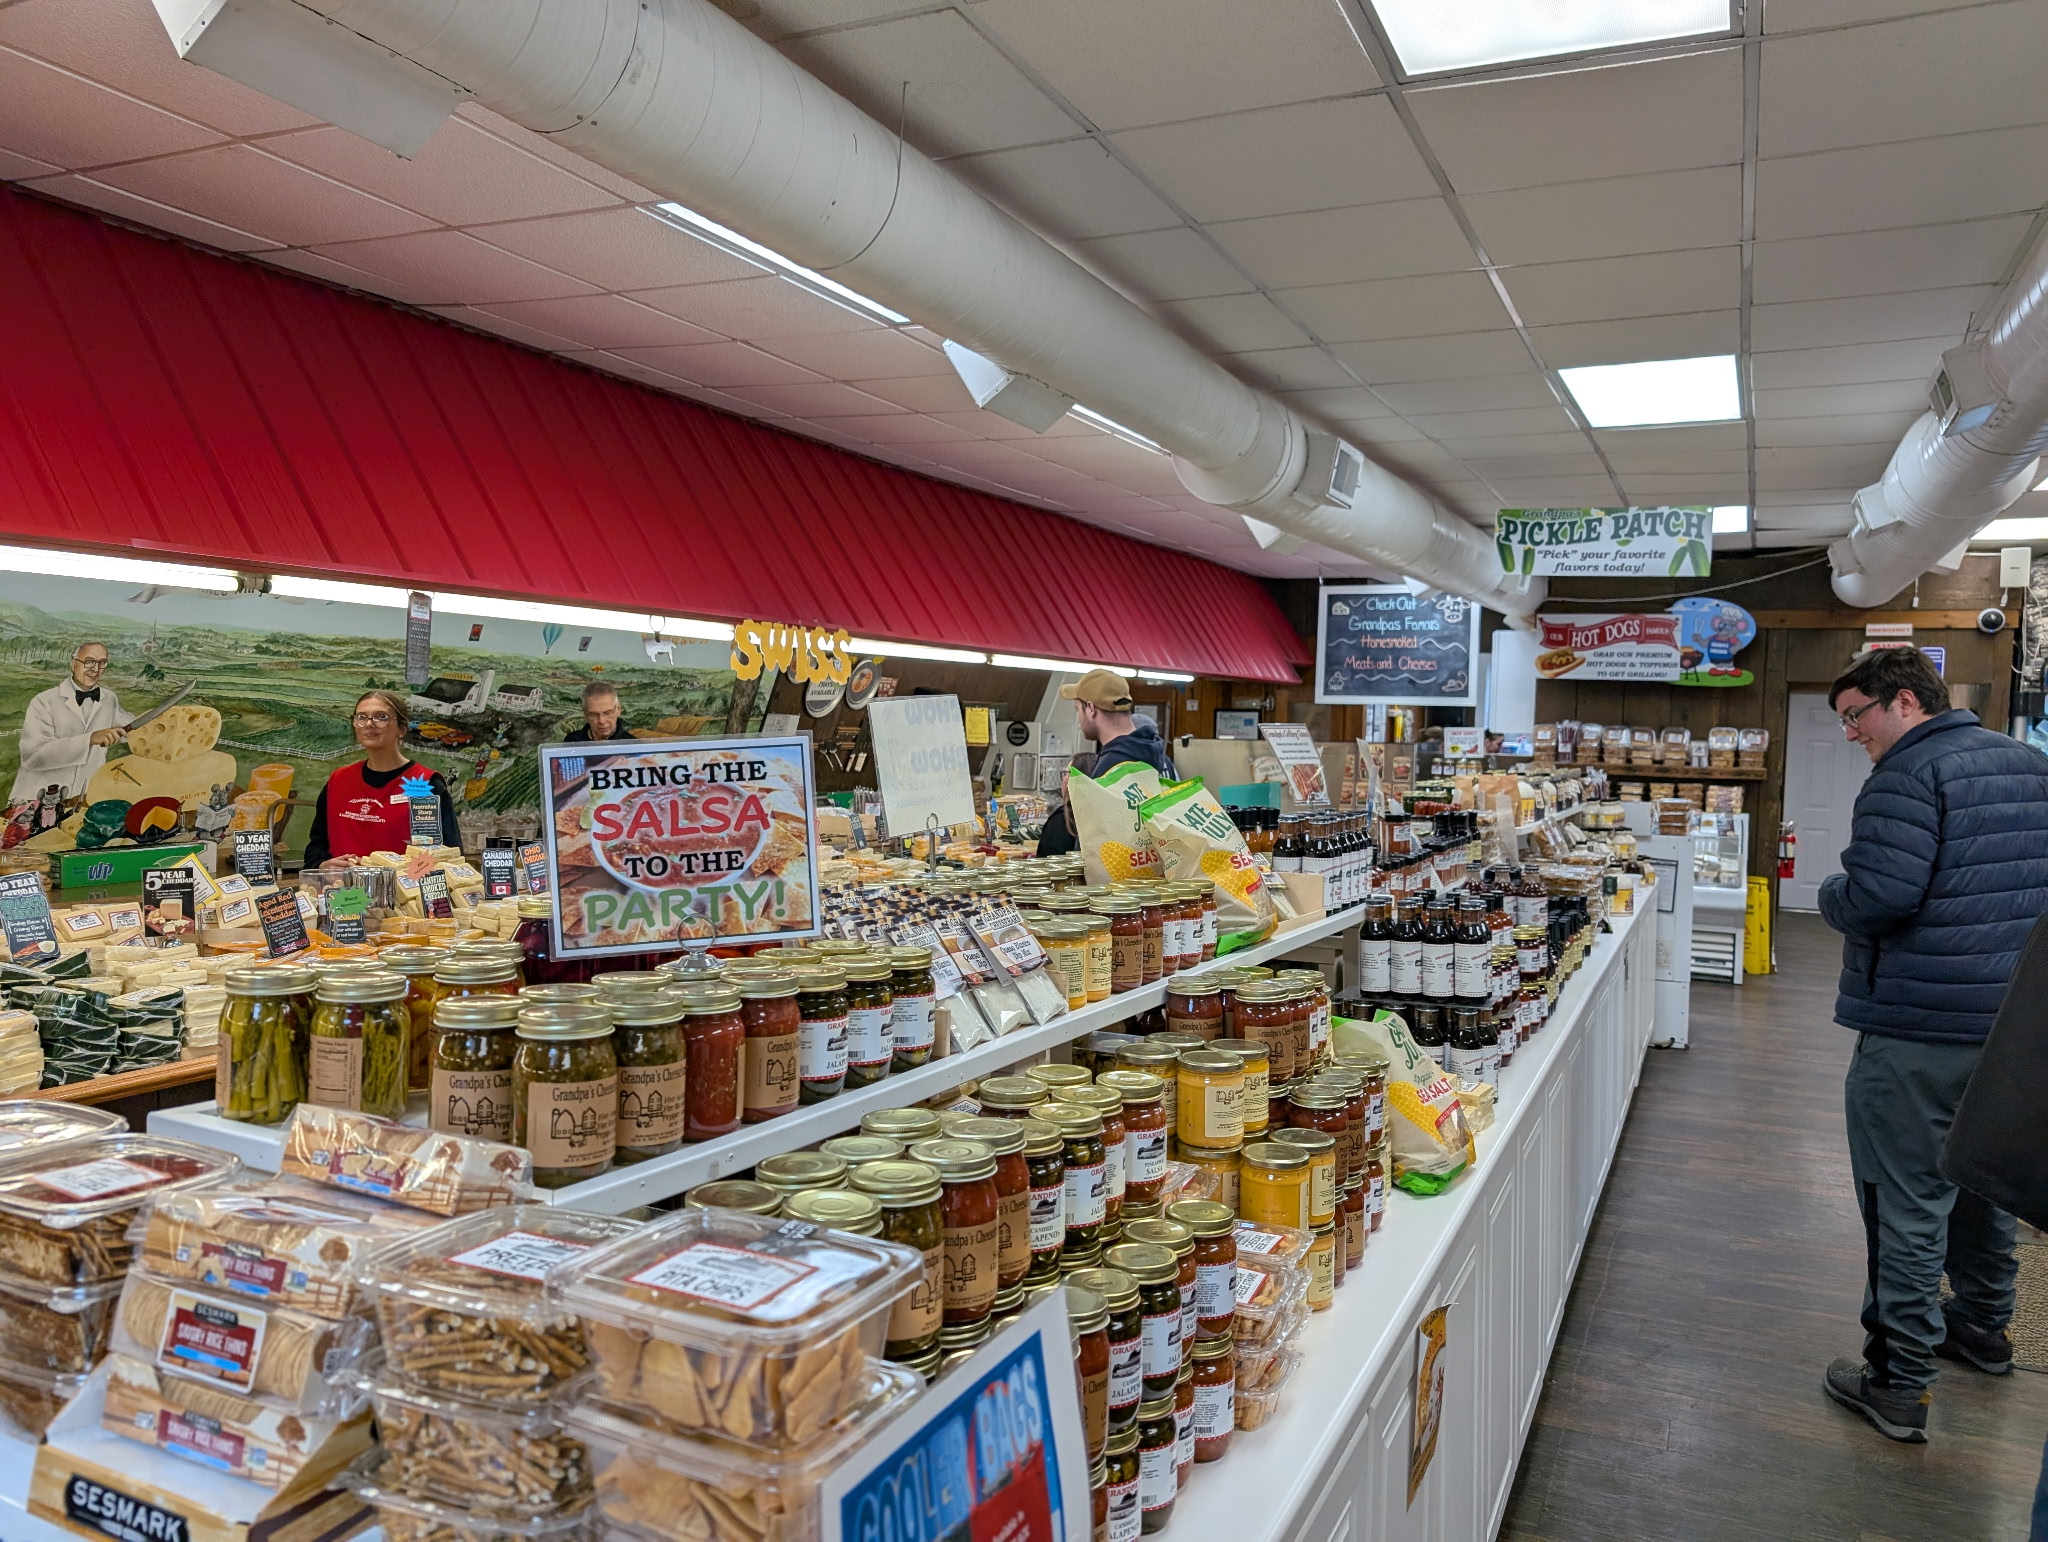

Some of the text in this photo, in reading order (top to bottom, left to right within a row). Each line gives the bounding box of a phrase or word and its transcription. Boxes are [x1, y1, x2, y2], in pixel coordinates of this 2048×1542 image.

[1501, 511, 1706, 546] PICKLE PATCH
[1580, 552, 1608, 561] your
[1612, 550, 1666, 560] favorite
[1554, 563, 1645, 574] flavors today!
[1366, 596, 1417, 610] Check Out
[1404, 617, 1440, 631] Famous
[1572, 620, 1640, 647] HOT DOGS
[730, 618, 853, 685] SWISS
[1344, 656, 1438, 671] Meats and Cheeses
[590, 760, 768, 791] BRING THE
[592, 794, 771, 842] SALSA
[1176, 802, 1213, 831] LATE
[235, 834, 269, 844] 10 YEAR
[236, 843, 270, 852] CHEDDAR
[524, 846, 541, 856] OHIO
[483, 851, 513, 859] CANADIAN
[624, 850, 745, 878] TO THE
[9, 877, 38, 889] YEAR
[145, 871, 186, 891] 5 YEAR
[422, 883, 446, 893] SMOKED
[278, 893, 292, 902] Red
[424, 891, 448, 901] CHEDDAR
[584, 880, 785, 933] PARTY!
[983, 900, 1016, 923] GRANDPA'S
[265, 910, 297, 923] Cheddar
[1000, 944, 1013, 956] Queso
[1014, 952, 1024, 960] Dip
[963, 952, 980, 963] Queso
[976, 959, 988, 969] Dip
[1257, 1028, 1282, 1039] Grandpa's
[449, 1074, 491, 1092] Grandpa's
[621, 1068, 661, 1087] Grandpa's
[553, 1085, 595, 1103] Grandpa's
[1416, 1077, 1453, 1104] SEA SALT
[1146, 1166, 1163, 1175] SALSA
[653, 1269, 751, 1301] PITA CHIPS
[197, 1304, 236, 1323] SESMARK
[975, 1354, 1044, 1489] BAGS
[72, 1480, 182, 1542] SESMARK
